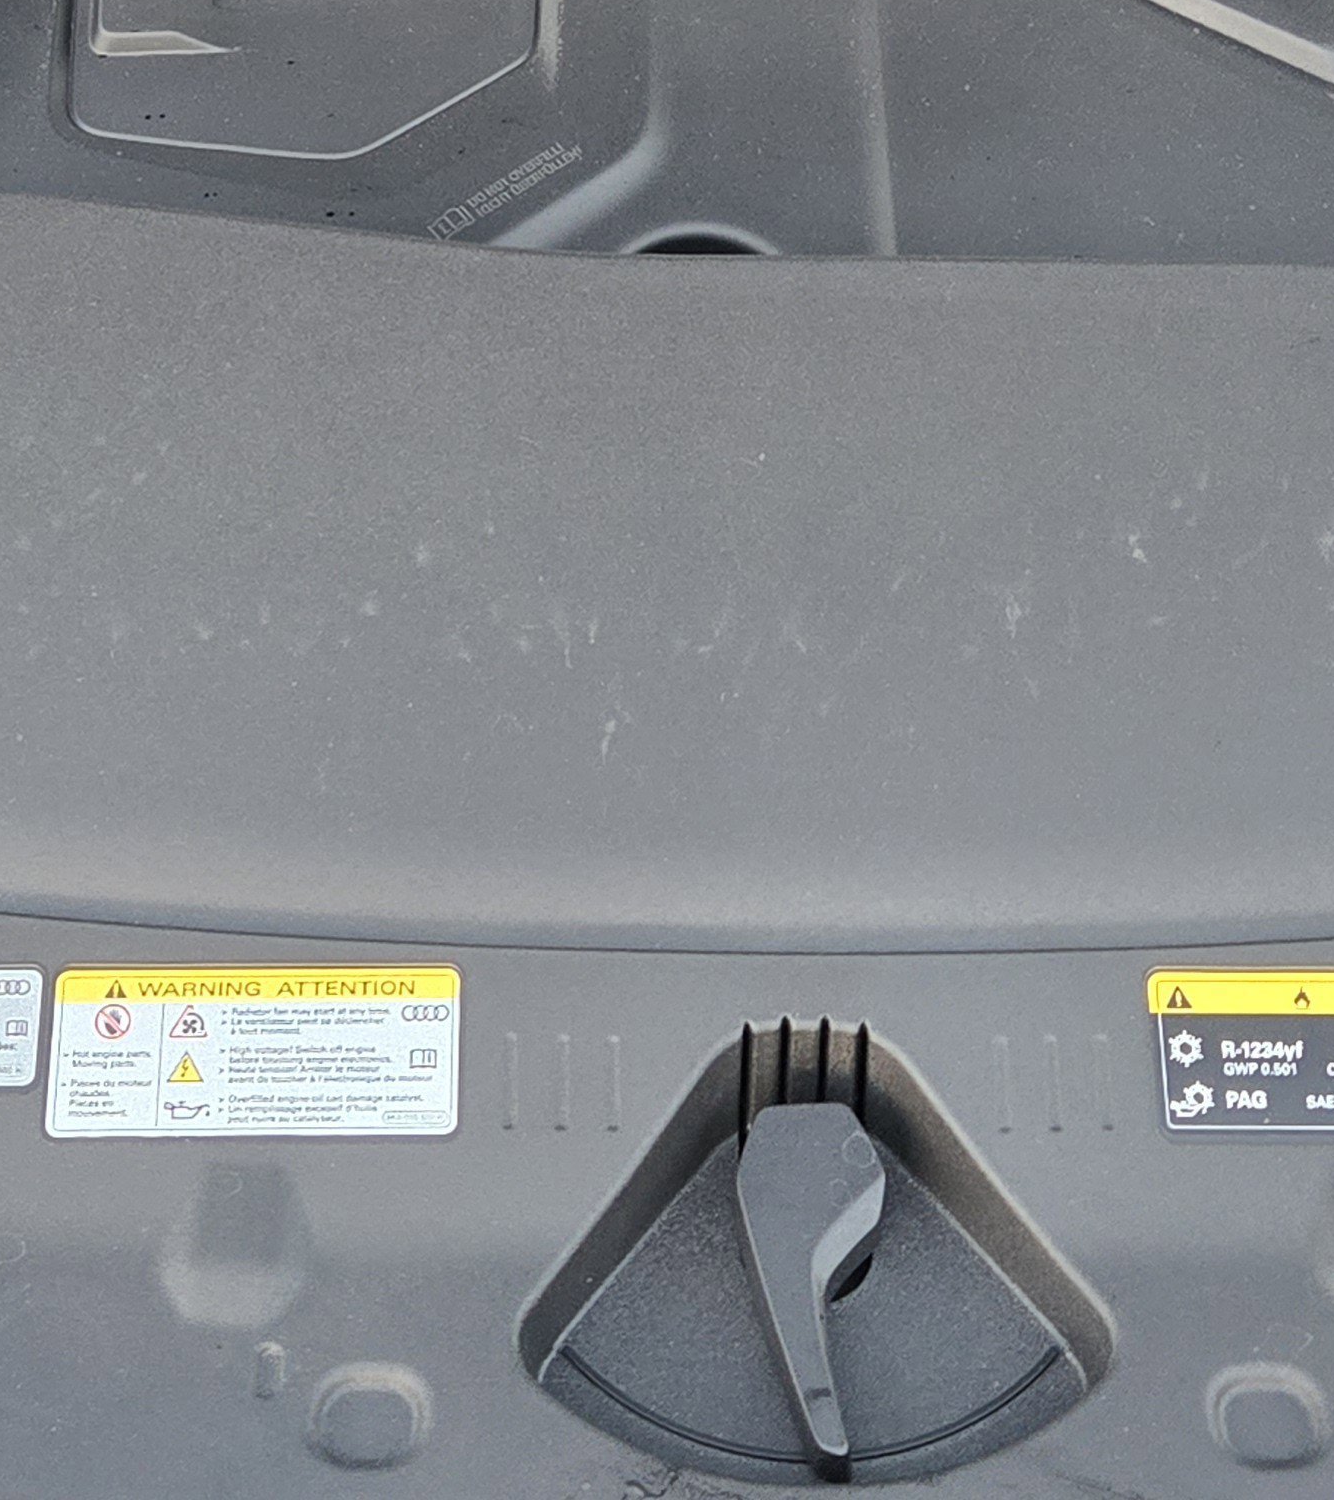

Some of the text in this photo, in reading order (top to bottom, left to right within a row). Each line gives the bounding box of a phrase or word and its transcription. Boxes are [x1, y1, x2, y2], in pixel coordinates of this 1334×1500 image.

[467, 192, 487, 208] DO
[483, 178, 510, 196] NOT
[138, 980, 416, 997] WARNING ATTENTION
[1221, 1040, 1304, 1061] R-1234yf
[1223, 1062, 1298, 1077] GWP 0.501
[1225, 1090, 1268, 1110] PAG
